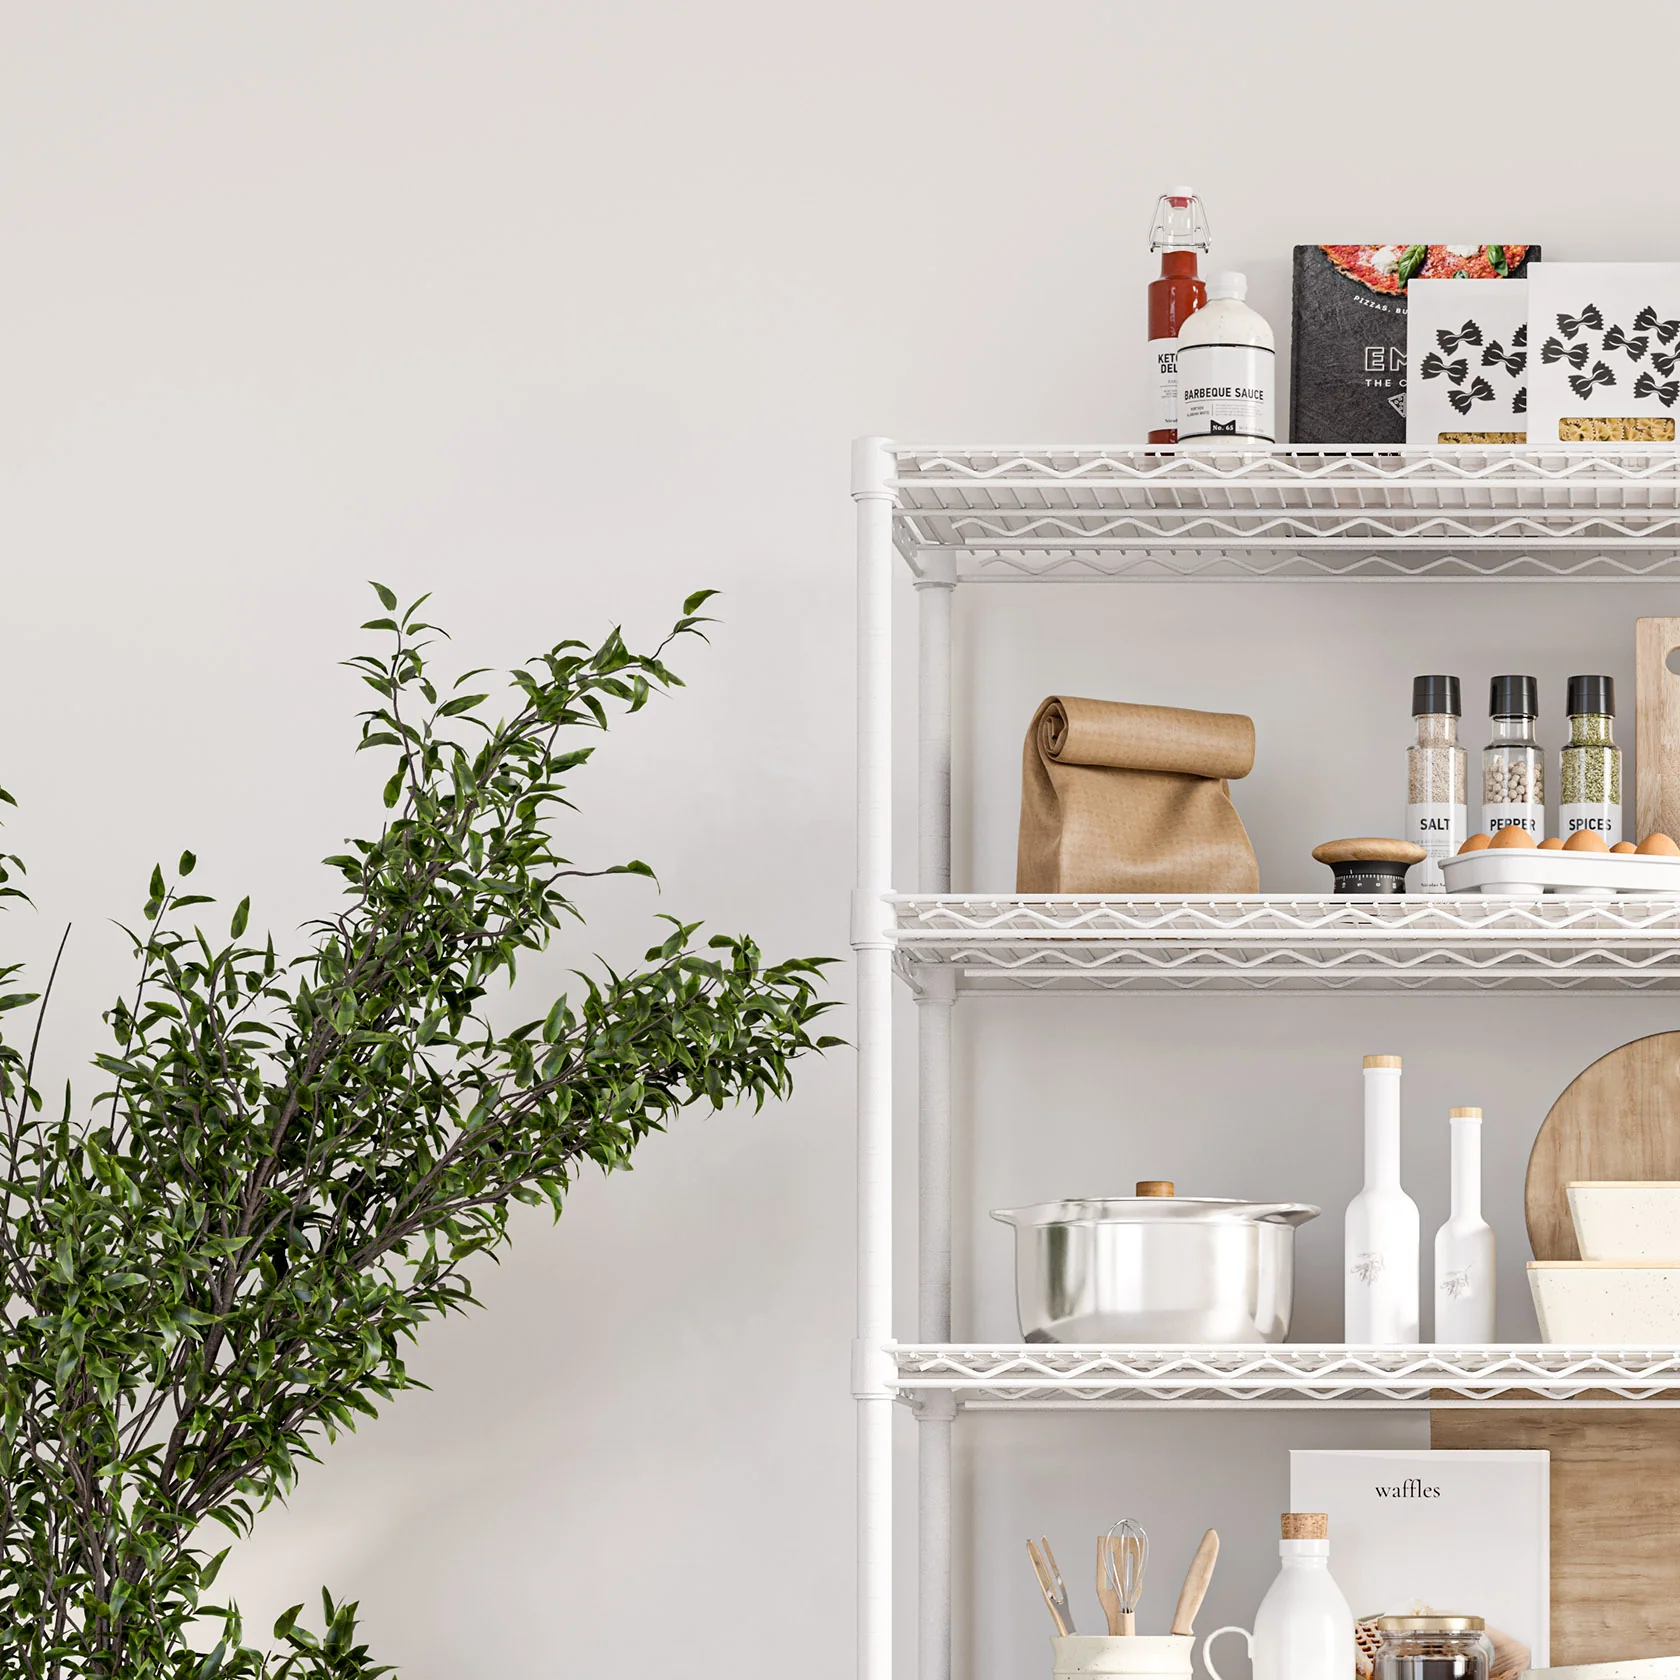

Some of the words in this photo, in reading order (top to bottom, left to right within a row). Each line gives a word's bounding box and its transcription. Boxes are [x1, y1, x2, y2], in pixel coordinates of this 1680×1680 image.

[1365, 379, 1392, 387] THE
[1184, 388, 1231, 400] BARBEQUE
[1235, 388, 1264, 400] SAUCE
[1420, 818, 1451, 831] SALT
[1490, 818, 1536, 831] PEPPER
[1569, 818, 1612, 831] SPICES
[1375, 1478, 1441, 1499] waffles
